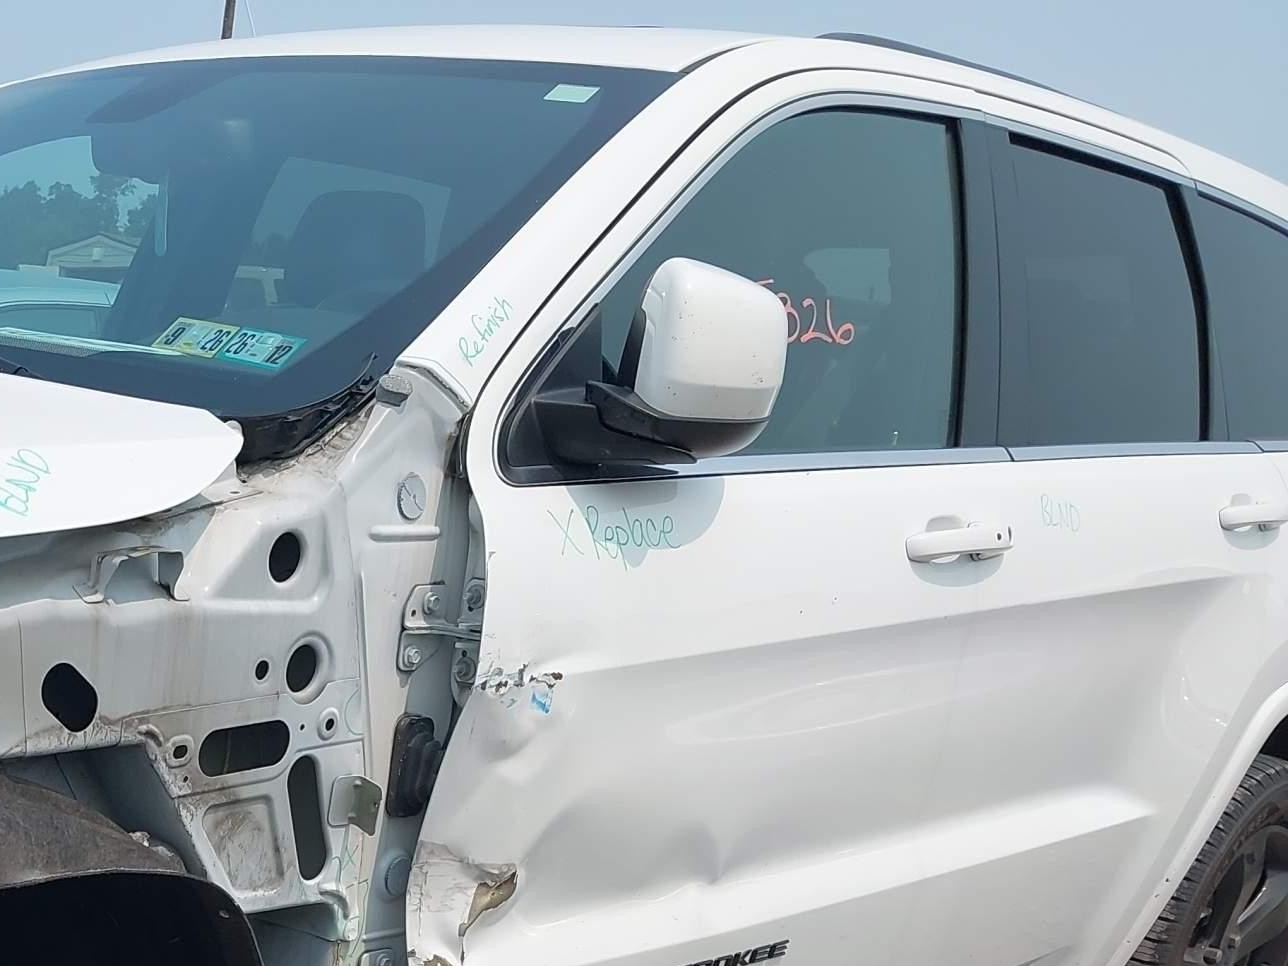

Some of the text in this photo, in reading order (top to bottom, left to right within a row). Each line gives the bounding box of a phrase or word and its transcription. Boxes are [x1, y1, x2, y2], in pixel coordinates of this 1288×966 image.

[200, 329, 232, 352] 26
[225, 332, 293, 365] 26 12
[459, 296, 514, 367] Refinish
[585, 505, 682, 571] Replace
